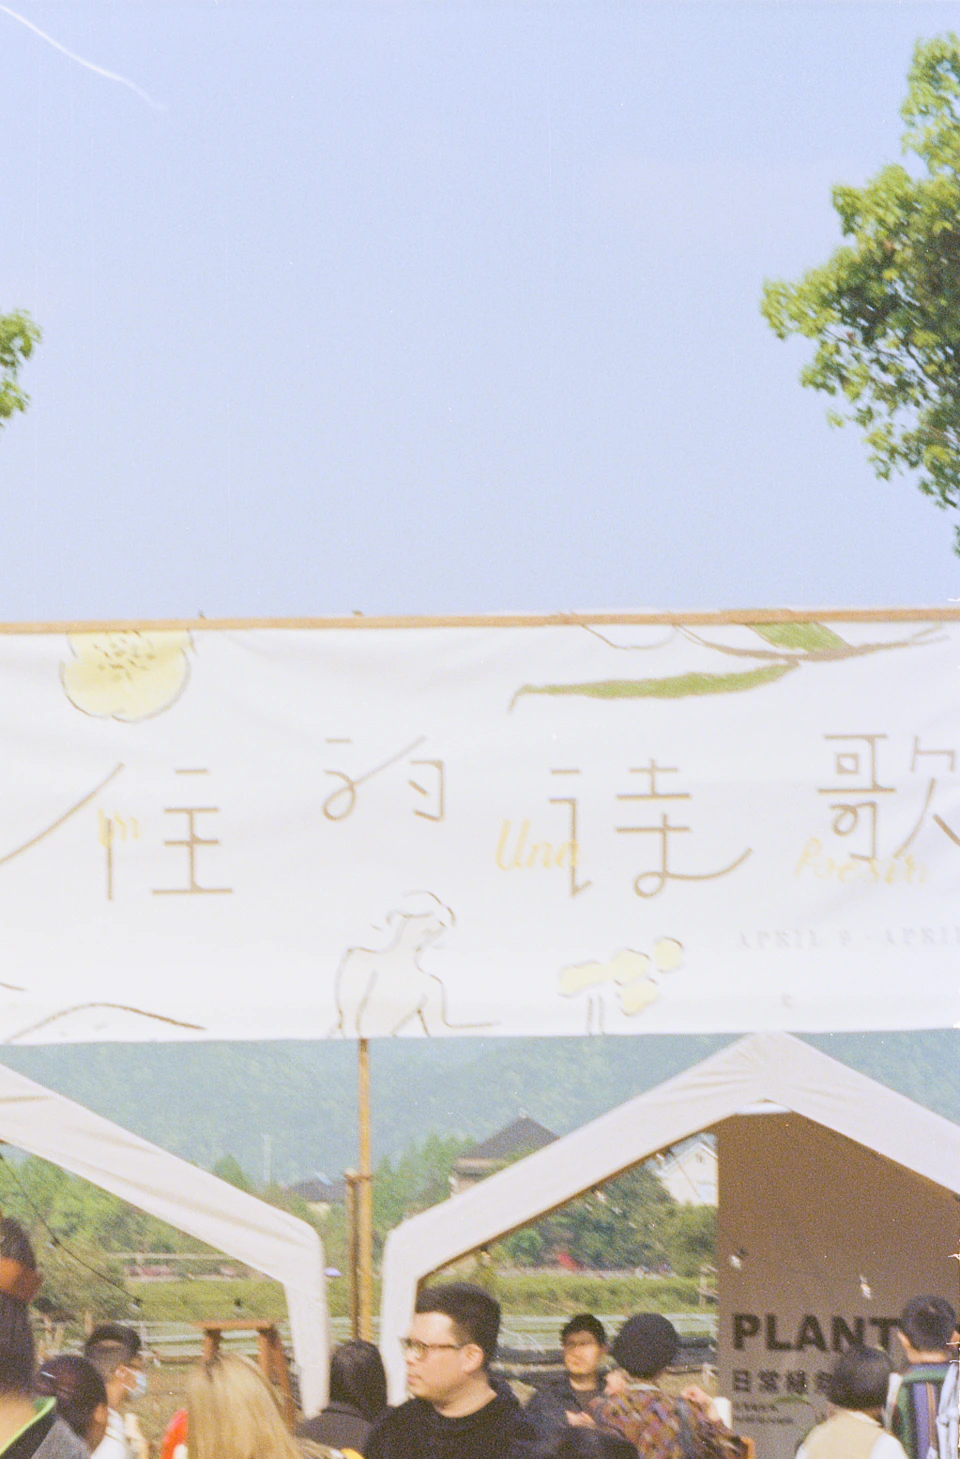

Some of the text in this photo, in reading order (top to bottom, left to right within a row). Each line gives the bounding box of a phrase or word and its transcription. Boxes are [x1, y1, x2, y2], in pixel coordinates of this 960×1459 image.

[495, 817, 580, 871] Una
[736, 928, 821, 950] APRIL
[733, 1313, 904, 1352] PLANT
